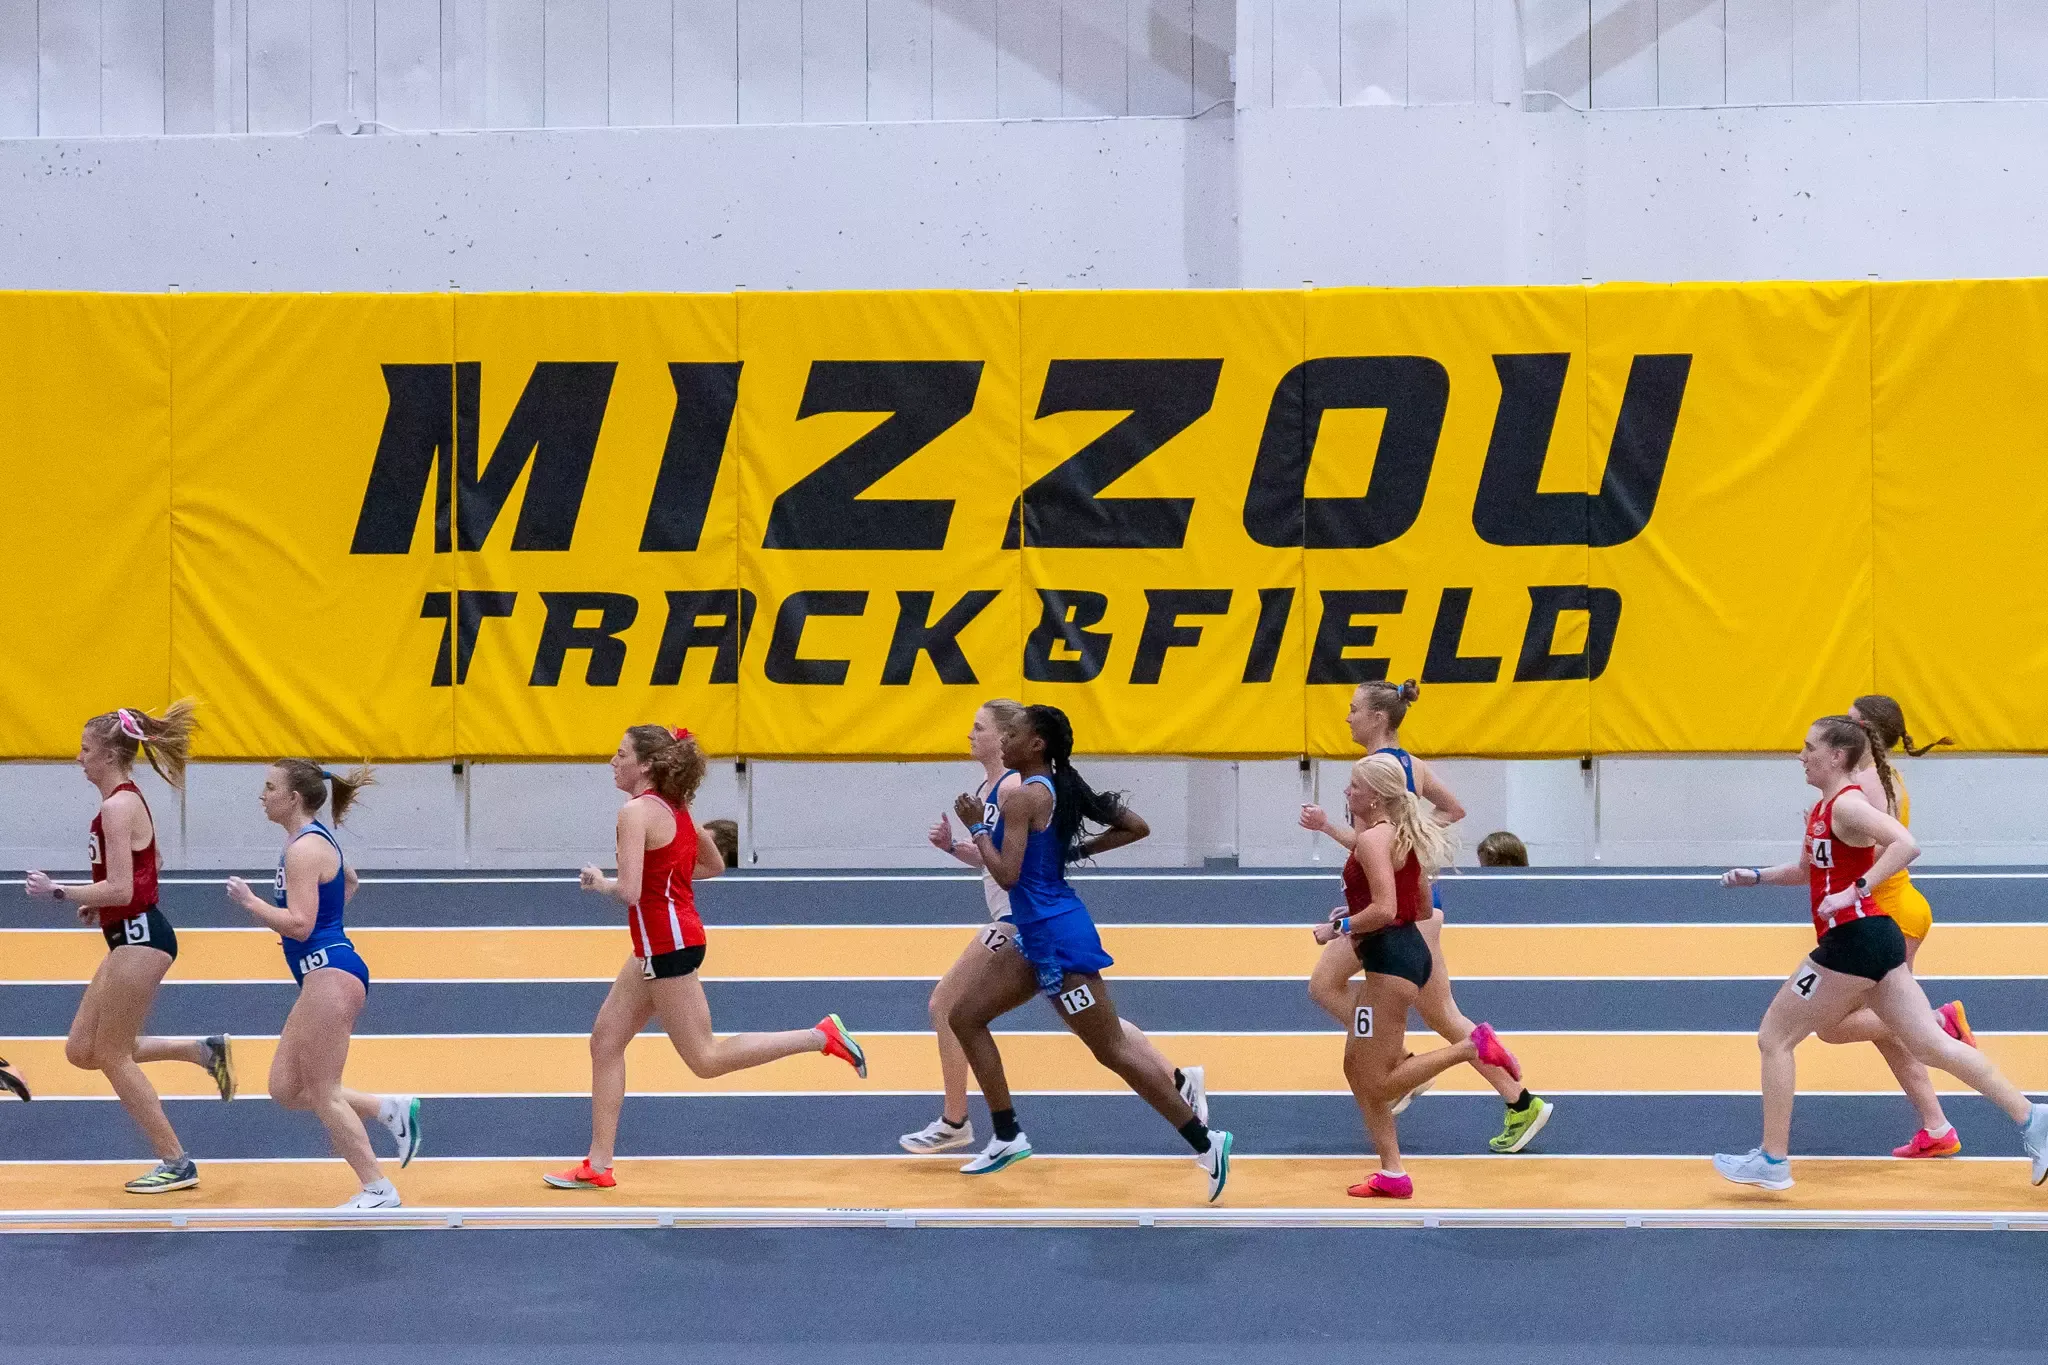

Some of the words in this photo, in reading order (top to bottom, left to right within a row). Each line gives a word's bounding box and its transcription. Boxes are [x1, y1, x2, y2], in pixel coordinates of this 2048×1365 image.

[350, 352, 1693, 554] MIZZOU
[1815, 841, 1829, 867] 4
[127, 916, 145, 941] 5
[984, 929, 1008, 952] 12
[1796, 972, 1818, 997] 4
[1062, 988, 1091, 1013] 13
[1356, 1008, 1370, 1035] 6
